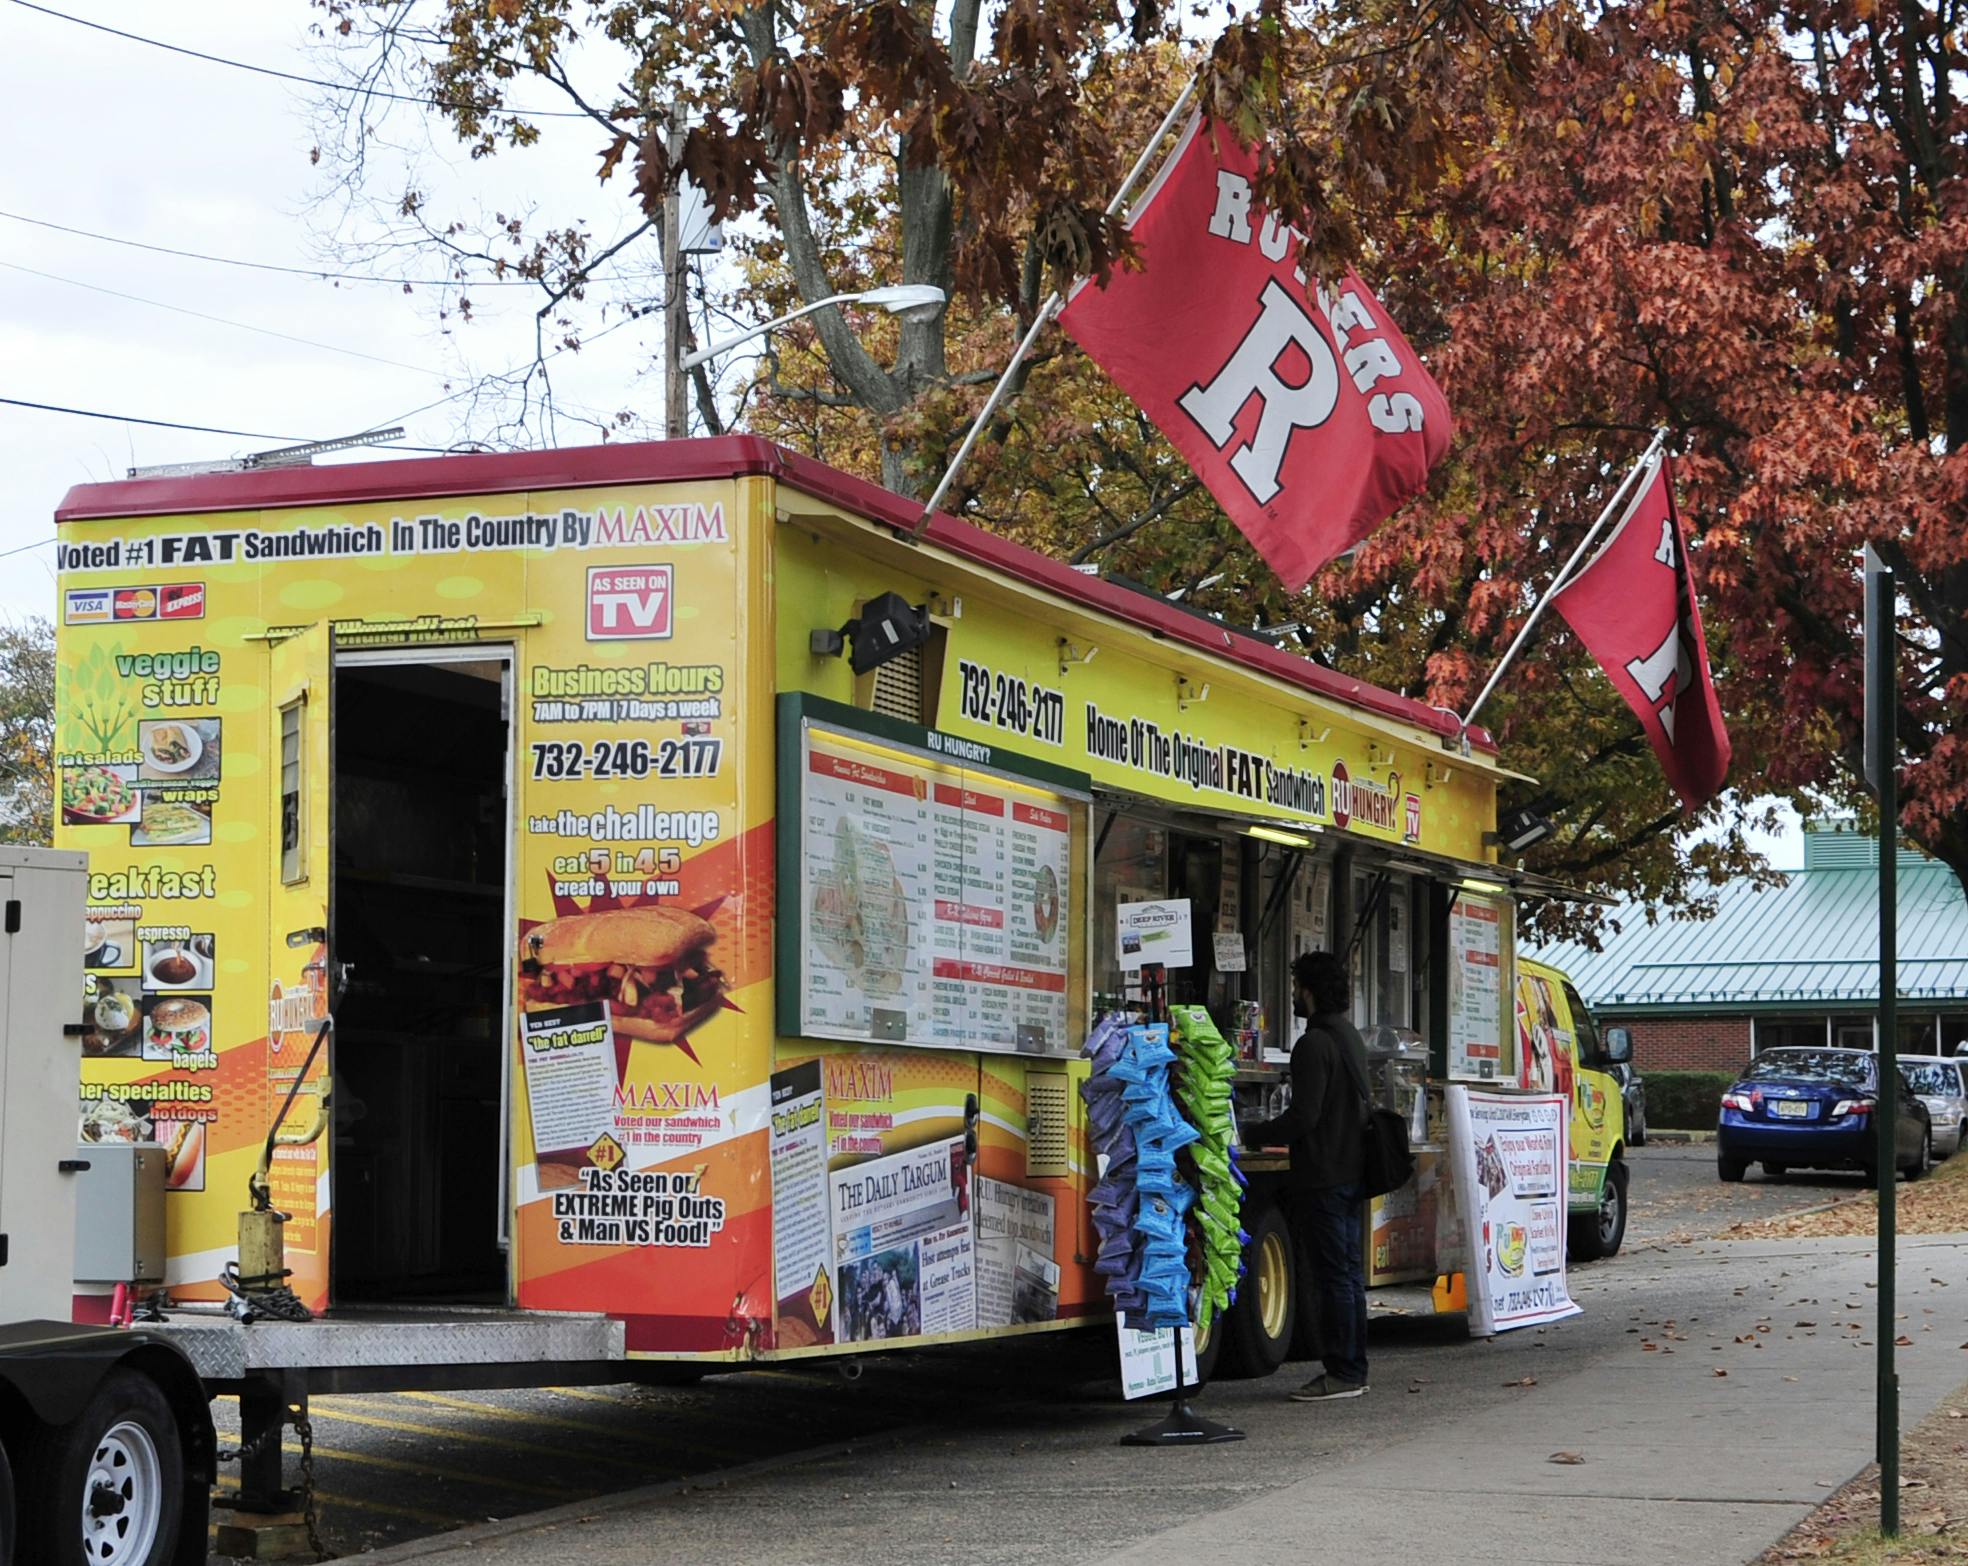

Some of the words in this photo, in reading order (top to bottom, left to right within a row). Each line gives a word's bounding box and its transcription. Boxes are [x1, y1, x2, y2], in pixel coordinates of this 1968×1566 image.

[1207, 168, 1424, 433] RUERS
[1175, 276, 1340, 506] R
[57, 542, 119, 570] Voted
[126, 539, 153, 565] #1
[161, 534, 240, 564] FAT
[245, 525, 381, 559] Sandwhich
[392, 521, 414, 551] In
[420, 519, 460, 549] The
[466, 514, 557, 548] Country
[563, 512, 591, 546] By
[595, 505, 725, 543] MAXIM
[593, 578, 611, 592] AS
[615, 577, 646, 590] SEEN
[649, 576, 666, 590] ON
[73, 600, 104, 612] VISA
[593, 592, 664, 628] TV
[116, 646, 220, 679] veggie
[143, 675, 220, 706] stuff
[533, 666, 645, 697] Business
[649, 663, 722, 694] Hours
[534, 702, 563, 721] 7AM
[564, 702, 579, 720] to
[582, 701, 610, 720] 7PM
[620, 700, 629, 719] 7
[630, 700, 666, 722] Days
[667, 704, 677, 718] a
[679, 699, 720, 717] week
[959, 660, 1064, 744] 732-246-2177
[532, 741, 720, 777] 732-246-2177
[927, 731, 941, 751] RU
[945, 738, 991, 764] HUNGRY?
[1086, 704, 1127, 764] Home
[1131, 718, 1145, 769] Of
[1147, 724, 1171, 776] The
[1173, 731, 1224, 790] Original
[1226, 748, 1264, 800] FAT
[1265, 760, 1325, 817] Sandwhich
[162, 789, 219, 803] wraps
[1332, 777, 1350, 815] RU
[529, 817, 557, 833] take
[558, 811, 589, 836] the
[591, 806, 719, 846] challenge
[554, 853, 588, 874] eat
[589, 849, 610, 874] 5
[616, 853, 634, 873] in
[87, 865, 216, 899] eakfast
[555, 876, 604, 896] create
[610, 880, 642, 898] your
[646, 880, 679, 895] own
[85, 902, 142, 923] appuccino
[137, 926, 190, 944] espresso
[552, 1033, 568, 1048] fat
[172, 1050, 218, 1071] bagels
[108, 1081, 212, 1103] specialties
[828, 1064, 892, 1099] MAXIM
[611, 1084, 720, 1109] MAXIM
[150, 1105, 218, 1123] hotdogs
[614, 1116, 644, 1129] Voted
[645, 1118, 663, 1129] our
[665, 1116, 721, 1129] sandwhich
[617, 1132, 631, 1143] #1
[632, 1132, 642, 1143] in
[644, 1131, 661, 1143] the
[662, 1132, 703, 1146] country
[594, 1145, 615, 1162] #1
[618, 1170, 669, 1192] Seen
[838, 1182, 864, 1212] THE
[865, 1171, 899, 1204] DAILY
[901, 1158, 947, 1192] TARGUM
[555, 1194, 638, 1216] EXTREME
[643, 1195, 674, 1221] Pig
[679, 1196, 723, 1218] Outs
[560, 1223, 574, 1240] &
[578, 1219, 621, 1240] Man
[625, 1221, 650, 1241] VS
